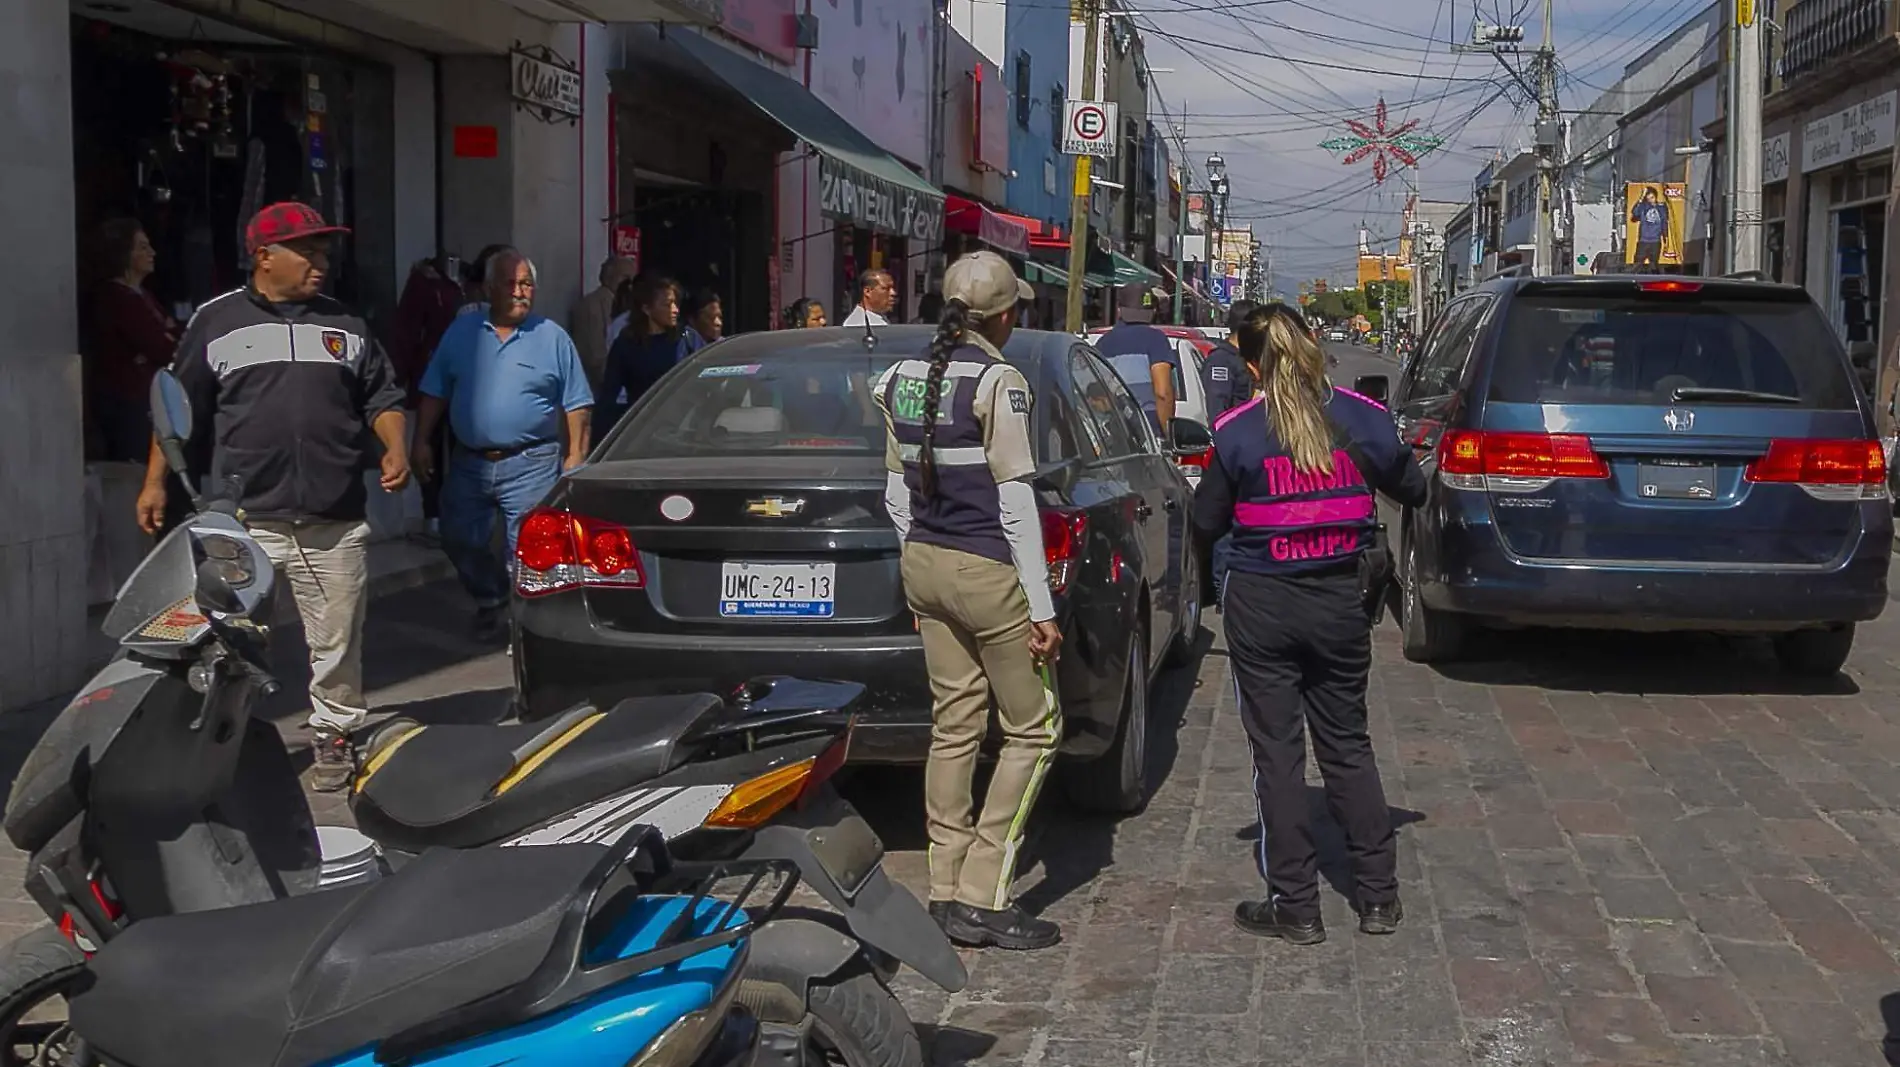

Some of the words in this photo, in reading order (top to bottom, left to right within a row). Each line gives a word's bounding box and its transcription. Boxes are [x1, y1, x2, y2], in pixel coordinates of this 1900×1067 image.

[1082, 112, 1098, 134] E
[897, 379, 952, 398] APOO
[725, 574, 830, 598] UMC-24-13
